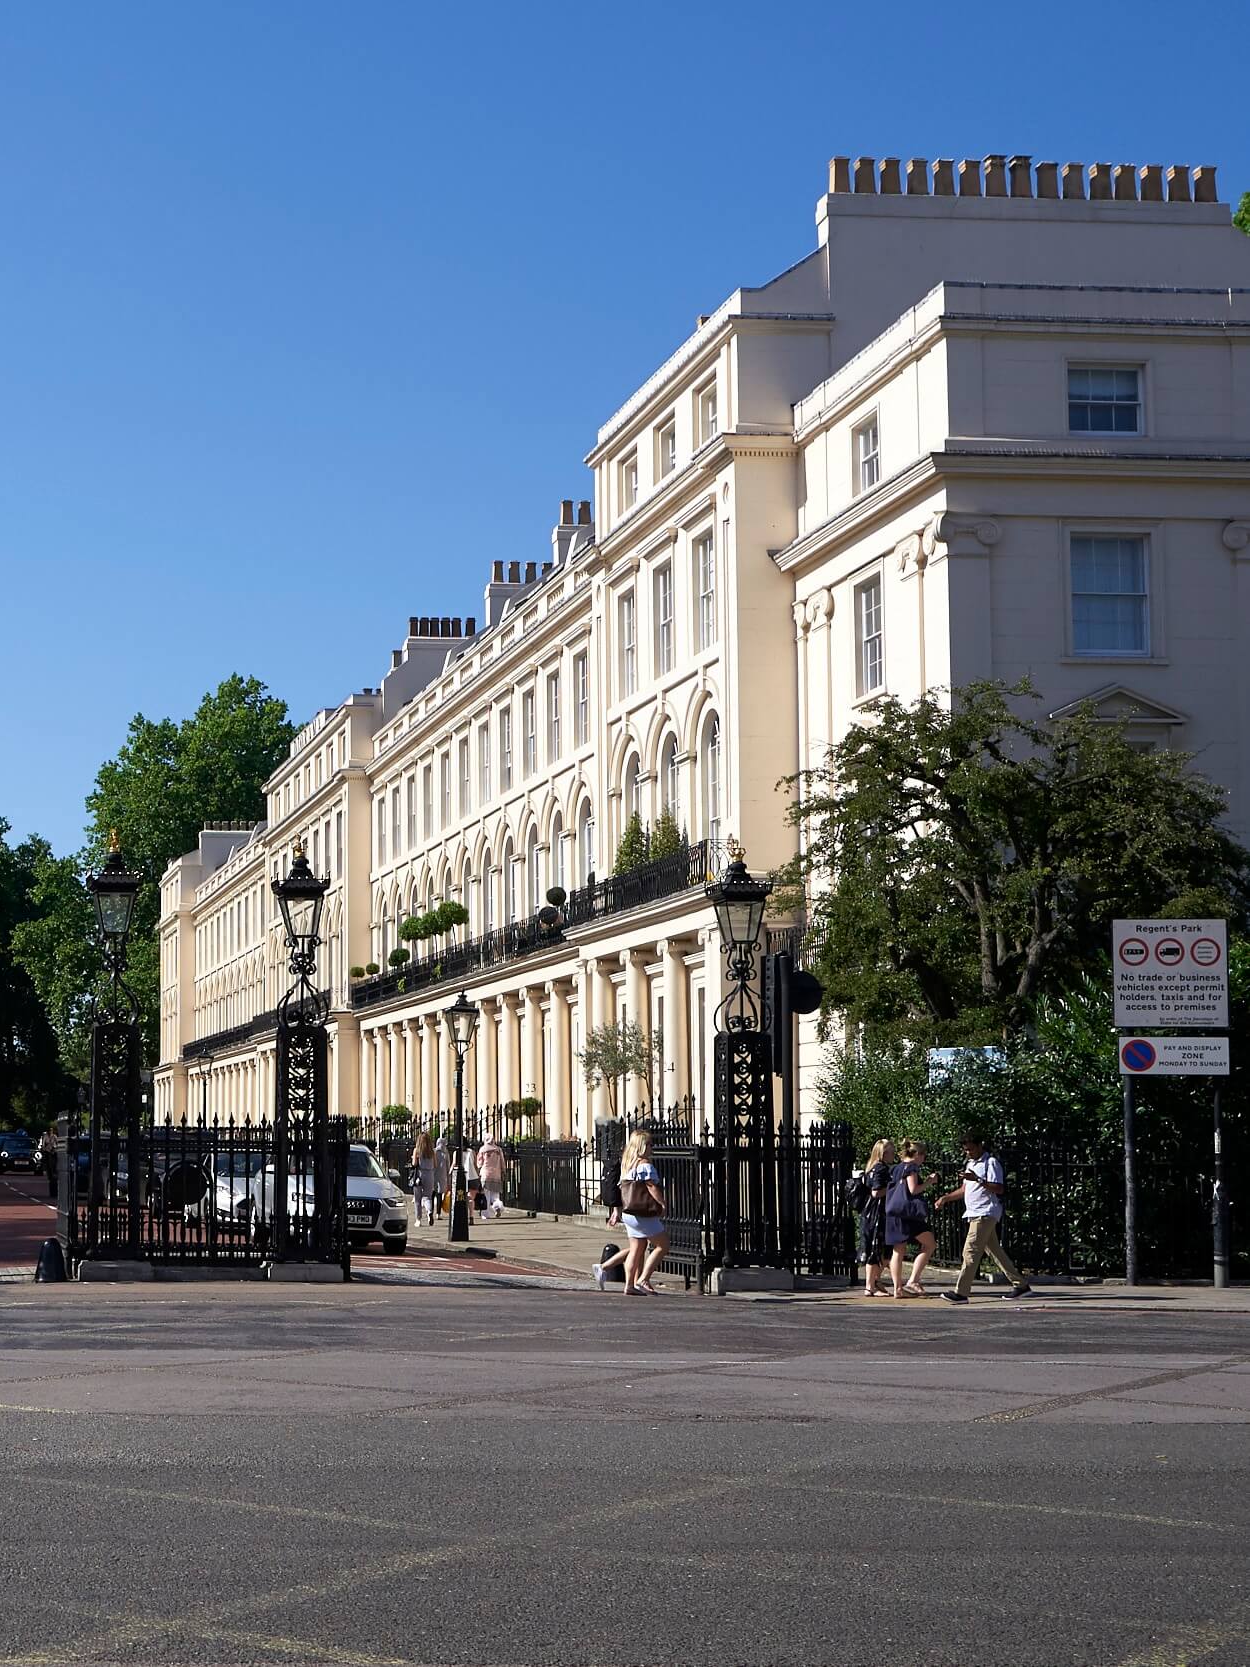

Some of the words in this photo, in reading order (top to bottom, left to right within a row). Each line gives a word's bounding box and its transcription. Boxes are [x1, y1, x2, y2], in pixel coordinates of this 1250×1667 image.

[1136, 925, 1177, 934] Regent's
[1182, 925, 1202, 933] Park
[1158, 985, 1190, 993] except
[1193, 984, 1225, 993] permit
[1187, 993, 1205, 1001] and
[1208, 993, 1222, 1001] for
[1174, 1003, 1217, 1011] premises
